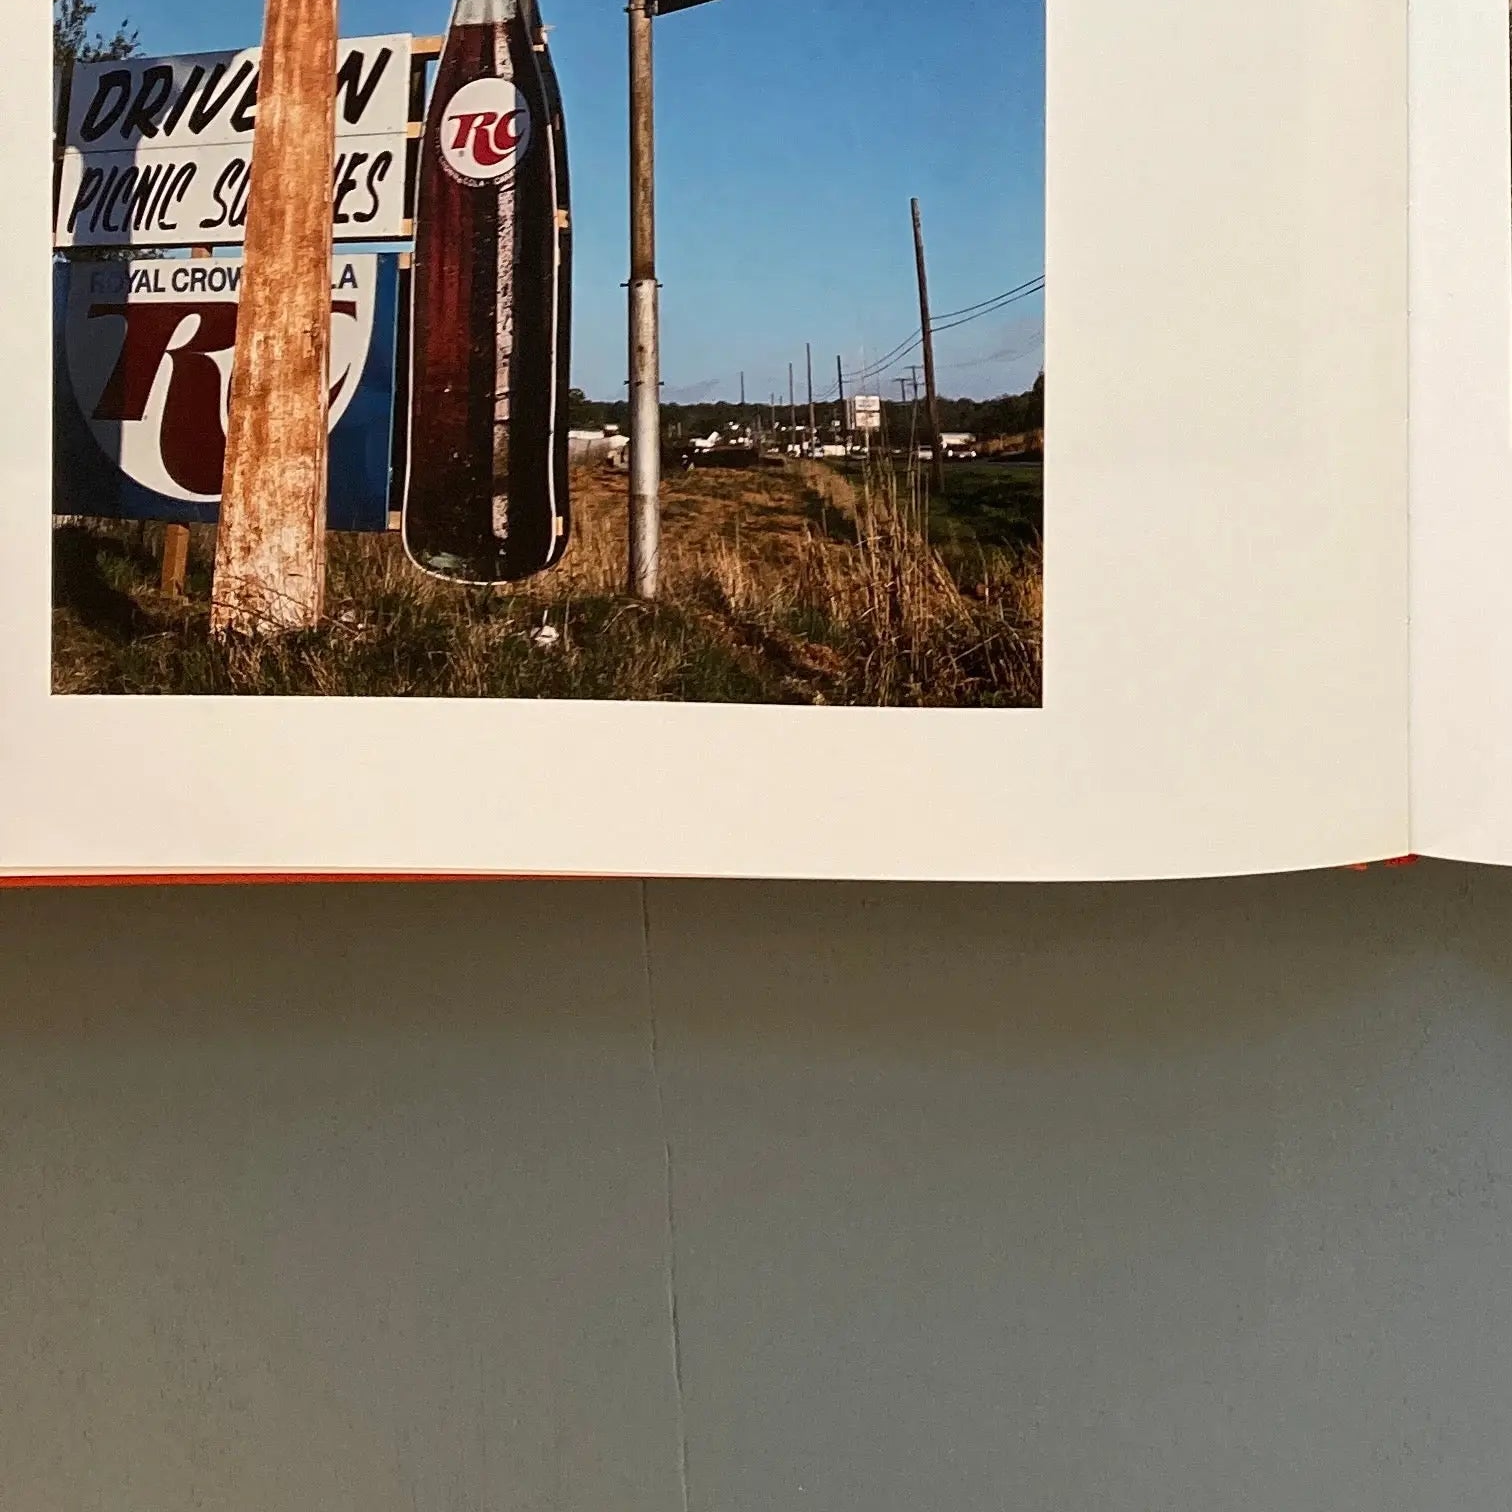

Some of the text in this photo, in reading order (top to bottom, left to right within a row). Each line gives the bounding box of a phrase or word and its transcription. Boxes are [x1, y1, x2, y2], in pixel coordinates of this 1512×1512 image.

[447, 107, 527, 167] RC
[66, 160, 198, 234] PICNIC
[171, 266, 243, 293] CROW
